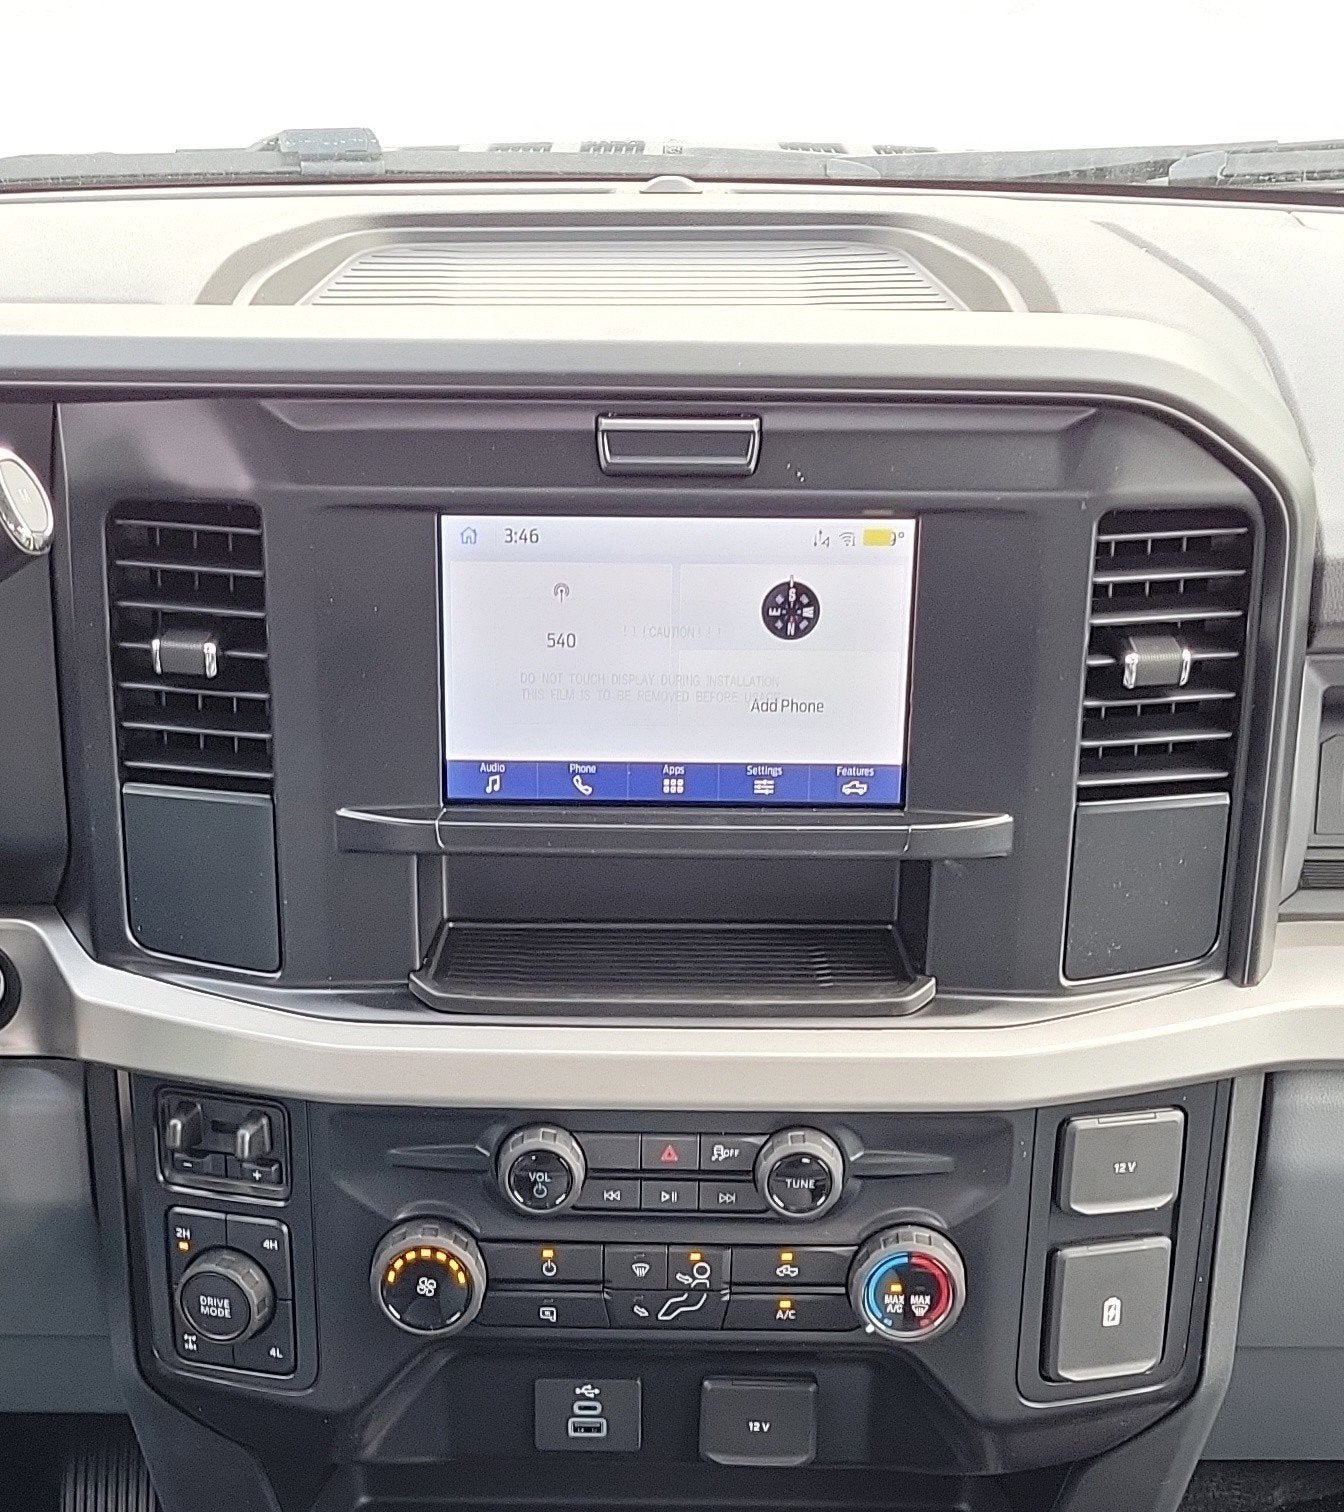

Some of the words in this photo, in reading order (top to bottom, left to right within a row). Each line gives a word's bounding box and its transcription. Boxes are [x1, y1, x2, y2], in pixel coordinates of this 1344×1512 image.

[504, 528, 539, 544] 3:46
[788, 588, 796, 602] S
[769, 608, 781, 617] E
[787, 622, 795, 635] N
[546, 632, 576, 649] 540
[520, 672, 535, 685] DO
[542, 673, 563, 685] NOT
[570, 673, 605, 685] TOUCH
[611, 674, 655, 686] DISPLAY
[660, 674, 700, 687] DURING
[706, 675, 780, 688] INSTALLATION
[750, 697, 778, 714] Add
[781, 697, 824, 714] Phone
[479, 763, 506, 773] Audio
[570, 764, 597, 774] Phone
[663, 765, 685, 777] Apps
[746, 765, 783, 777] Settings
[836, 766, 874, 777] Features
[723, 1147, 740, 1159] OFF
[528, 1171, 551, 1182] VOL
[785, 1178, 816, 1190] TUNE
[175, 1227, 191, 1240] 2H
[263, 1239, 278, 1251] 4H
[199, 1295, 230, 1309] DRIVE
[884, 1294, 905, 1305] MAX
[910, 1294, 931, 1305] MAX
[200, 1305, 231, 1319] MODE
[776, 1309, 797, 1322] A/C
[269, 1347, 283, 1359] 4L
